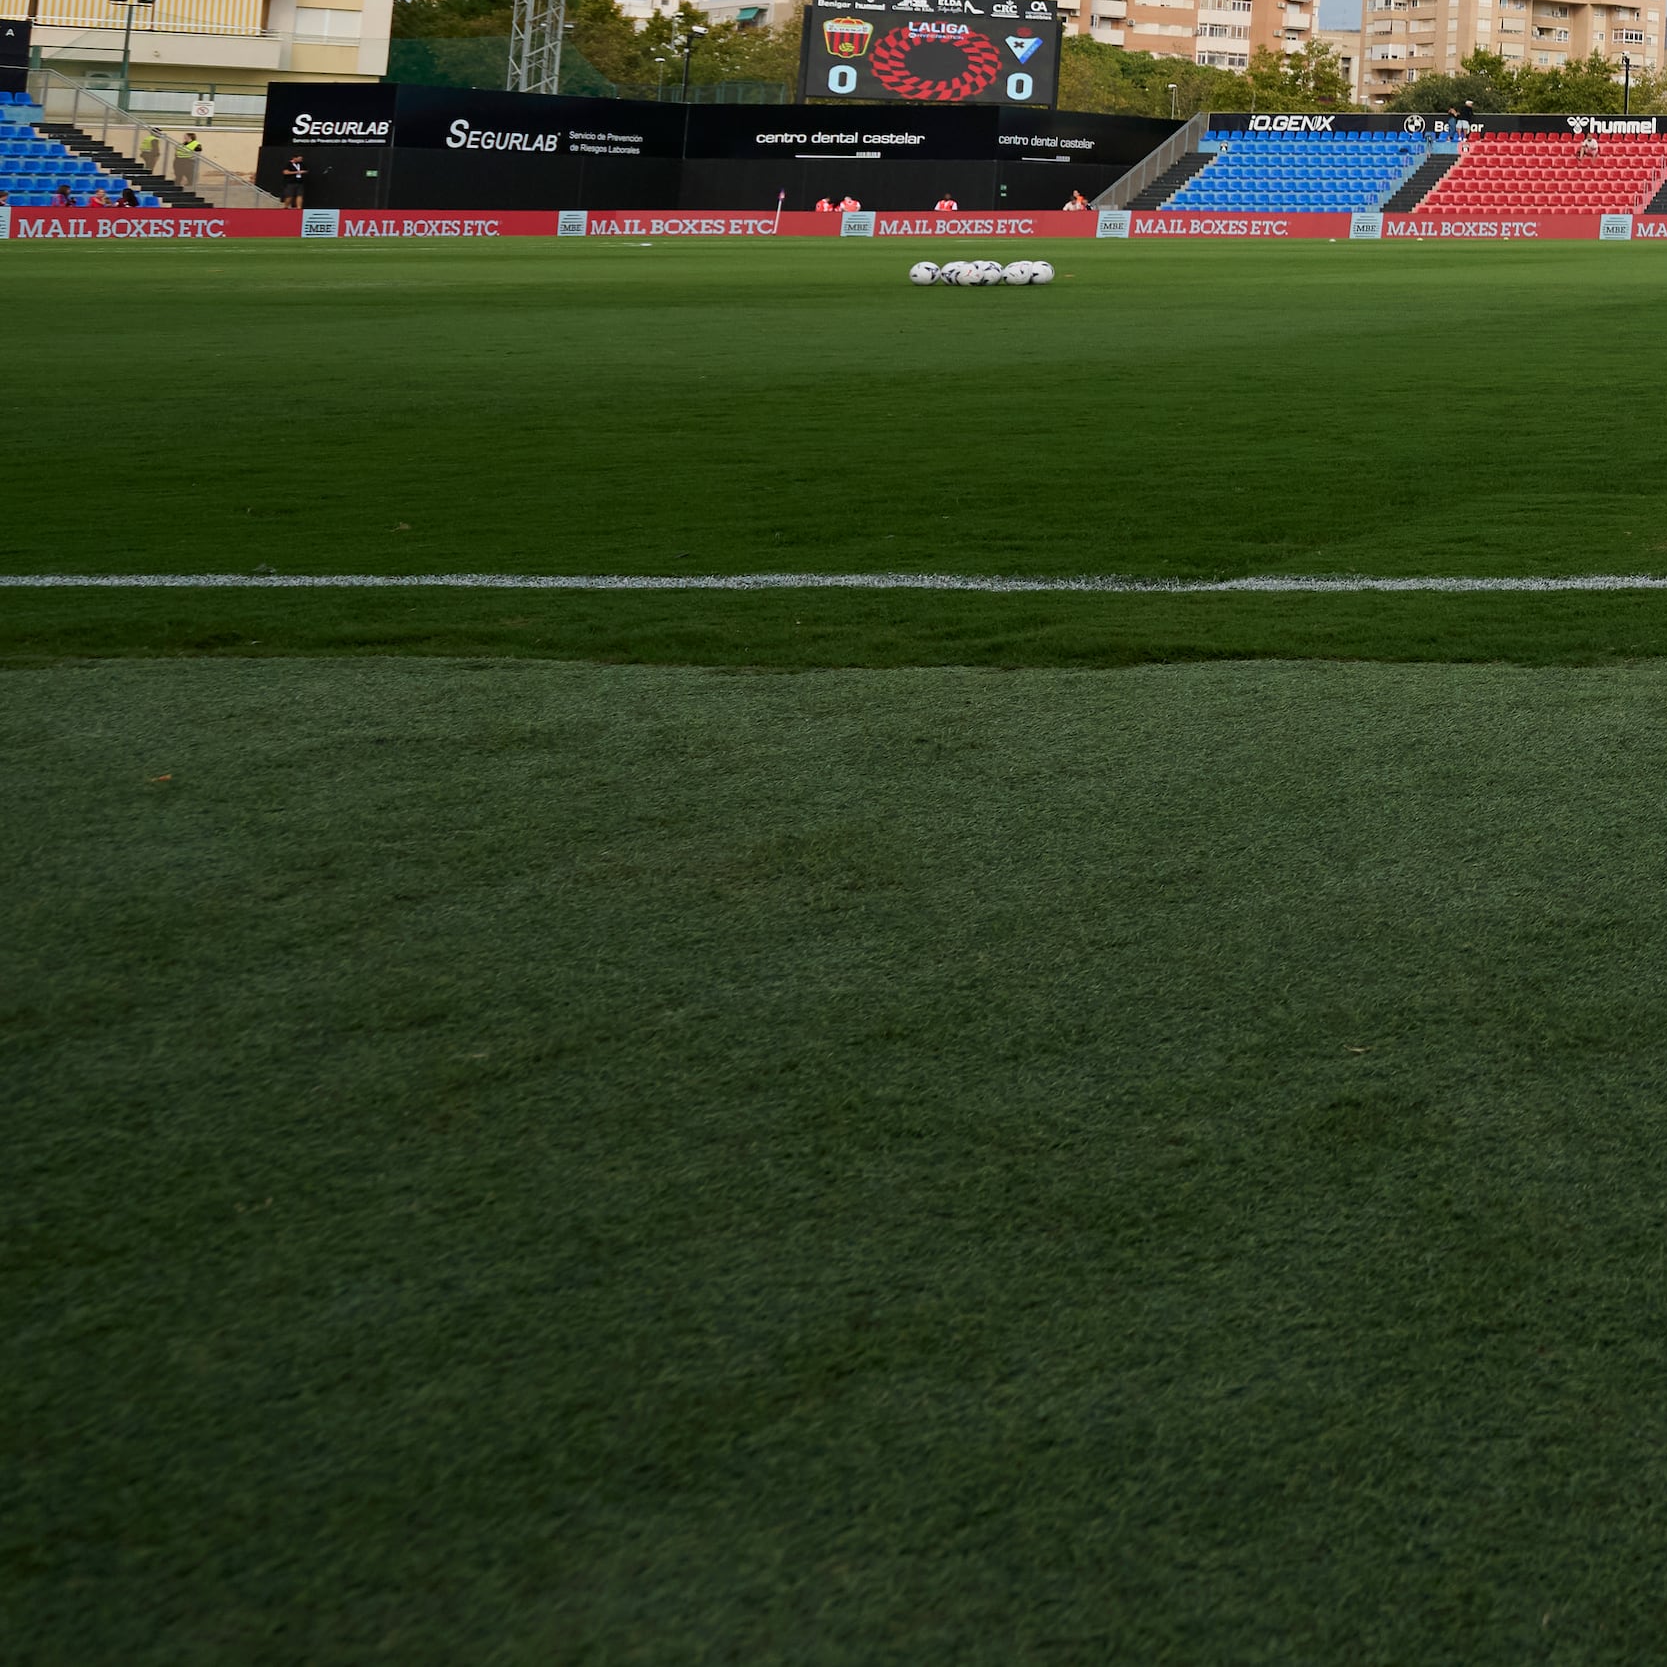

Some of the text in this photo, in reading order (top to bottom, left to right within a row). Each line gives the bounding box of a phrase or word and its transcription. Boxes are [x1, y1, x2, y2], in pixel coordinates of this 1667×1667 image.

[818, 0, 851, 8] Benigar
[855, 2, 885, 11] hummel
[938, 0, 962, 7] ELDA
[993, 4, 1018, 13] CRC
[6, 29, 15, 37] A
[909, 22, 969, 34] LALIGA
[828, 65, 857, 94] 0
[1006, 73, 1033, 100] 0
[1590, 117, 1657, 133] hummel
[569, 131, 643, 143] Servicio de Prevención
[756, 131, 925, 145] centro dental castelar
[999, 135, 1094, 150] centro dental castelar
[570, 144, 640, 155] de Riesgos Laborales
[17, 219, 92, 238] MAIL
[97, 219, 174, 238] BOXES
[177, 219, 226, 238] ETC.
[344, 220, 500, 237] MAIL BOXES ETC.
[590, 220, 776, 235] MAIL BOXES ETC.
[879, 220, 1033, 235] MAIL BOXES ETC.
[1134, 220, 1288, 235] MAIL BOXES ETC.
[1387, 221, 1538, 237] MAIL BOXES ETC.
